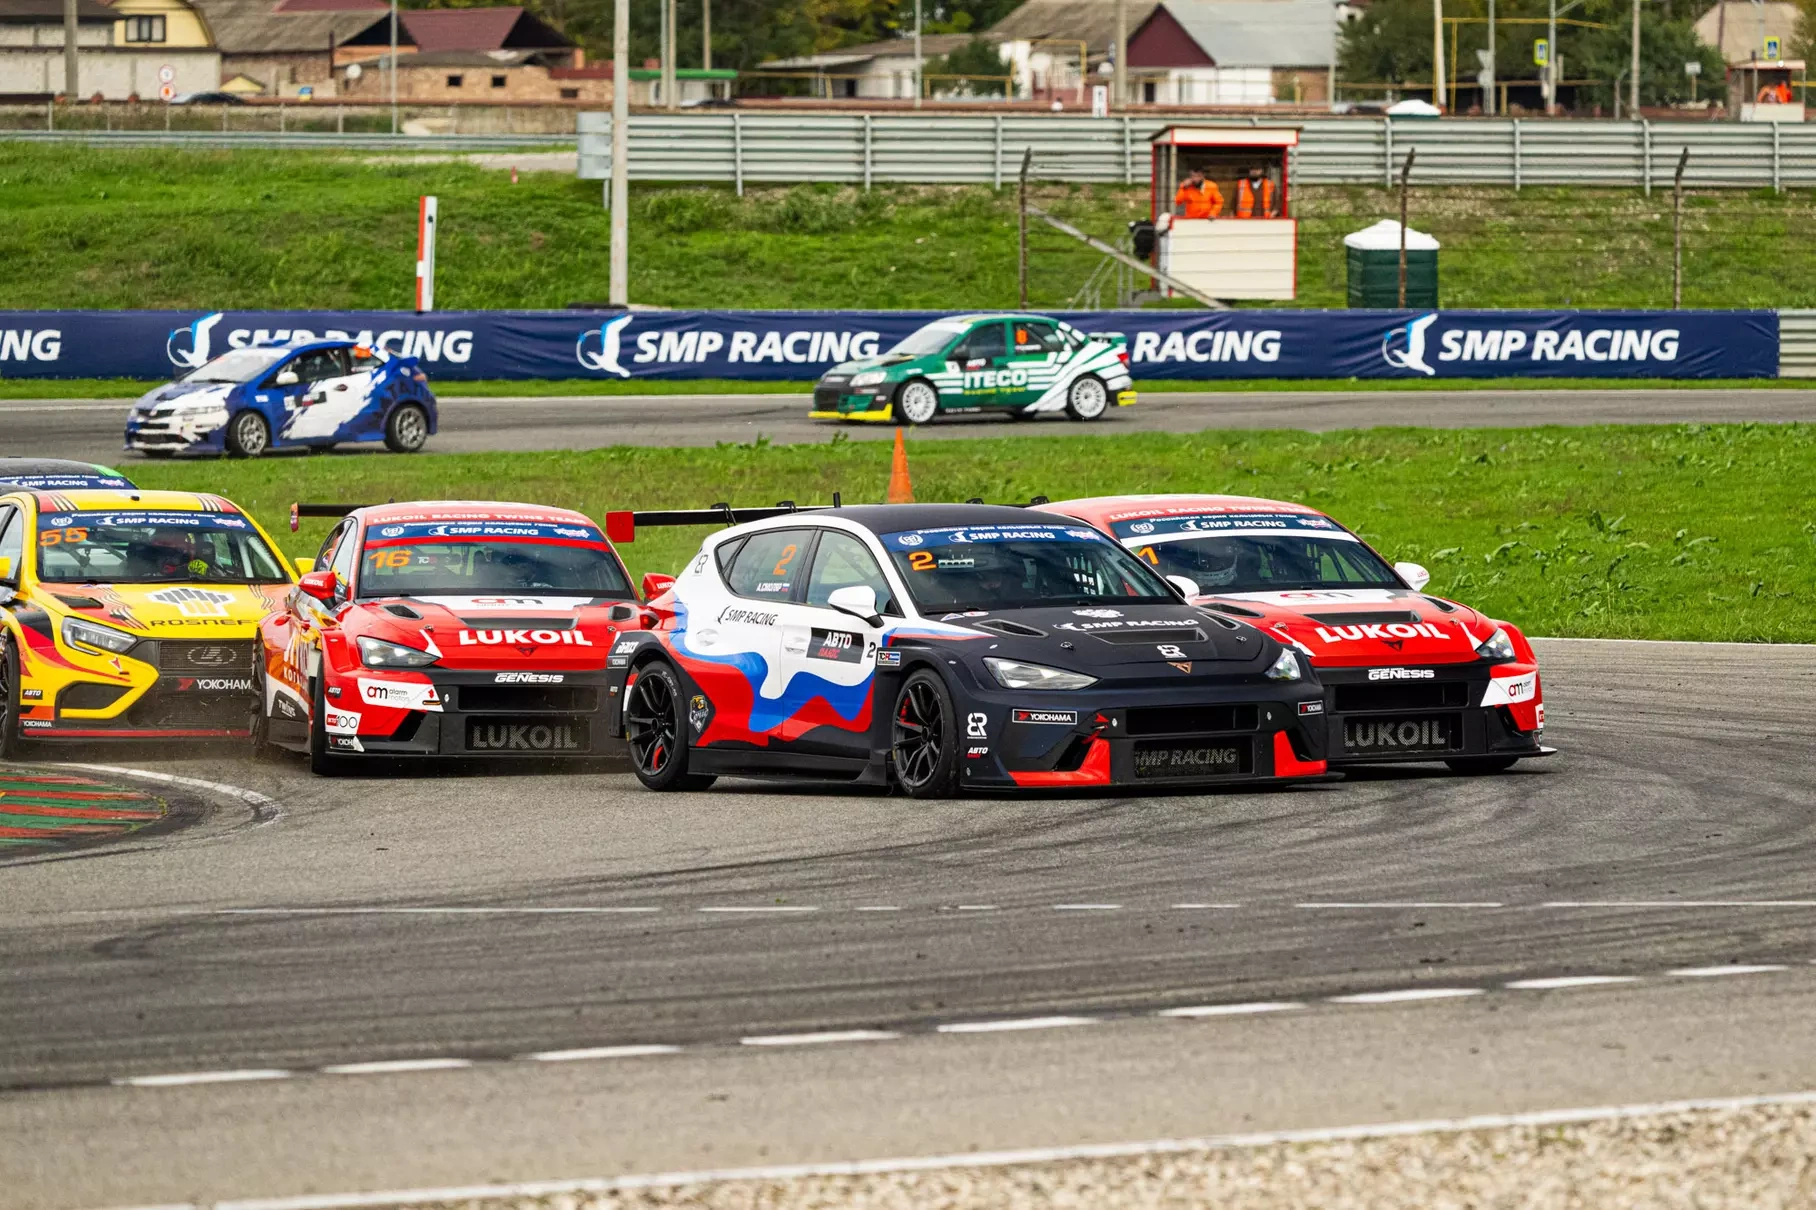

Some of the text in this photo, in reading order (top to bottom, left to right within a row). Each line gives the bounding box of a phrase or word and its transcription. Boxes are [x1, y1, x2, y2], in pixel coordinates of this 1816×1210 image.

[0, 329, 61, 361] NG
[633, 331, 880, 363] SMP RACING
[1132, 330, 1282, 362] RACING
[1438, 329, 1680, 361] SMP RACING
[963, 369, 1028, 389] ITECO
[116, 517, 200, 526] SMP RACING
[373, 512, 588, 525] LUKOIL RACING TWINS TEAM
[1109, 508, 1164, 520] LUKOIL
[1166, 506, 1226, 515] RACING
[449, 527, 539, 536] SMP RACING
[1201, 520, 1233, 529] SMP
[1234, 520, 1287, 528] RACING
[39, 527, 88, 547] 55
[970, 531, 1001, 541] SMP
[1002, 530, 1056, 540] RACING
[368, 550, 412, 569] 16
[772, 544, 797, 576] 2
[908, 551, 937, 571] 2
[725, 609, 779, 626] SMP RACING
[1081, 619, 1200, 630] SMP RACING
[458, 629, 593, 647] LUKOIL
[822, 631, 853, 650] АВТО
[1314, 623, 1452, 644] LUKOIL
[866, 641, 876, 658] 2
[494, 674, 564, 684] GENESIS
[1368, 670, 1435, 681] GENESIS
[196, 679, 253, 690] YOKOHAM
[1030, 713, 1072, 722] YOKOHAMA
[472, 724, 579, 749] LUKOIL
[1343, 719, 1446, 748] LUKOIL
[1170, 748, 1237, 765] RACING
